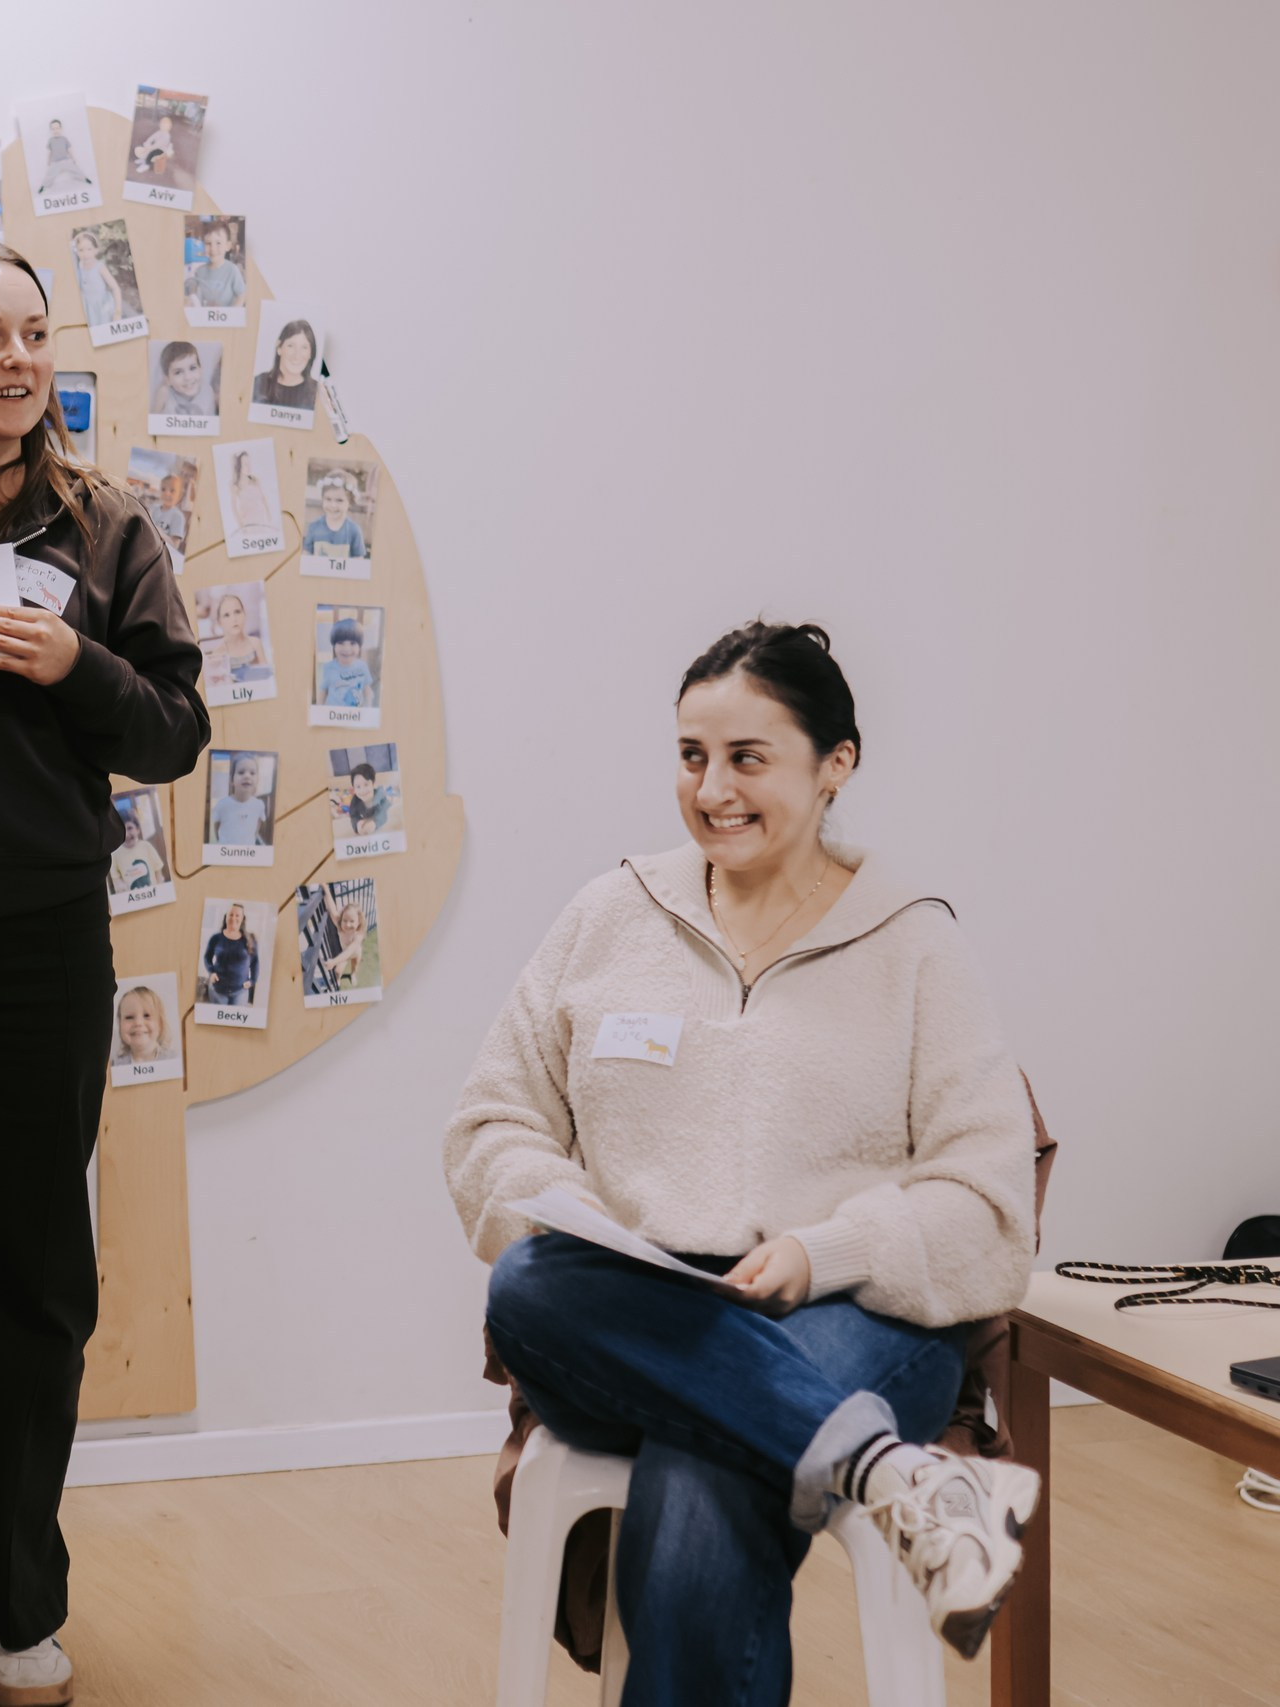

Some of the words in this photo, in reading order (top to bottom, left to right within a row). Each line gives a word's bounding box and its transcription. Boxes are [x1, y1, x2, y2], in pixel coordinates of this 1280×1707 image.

[43, 194, 78, 210] David
[80, 192, 90, 204] S
[148, 188, 176, 203] Aviv
[207, 310, 228, 322] Rio
[109, 319, 144, 336] Maya
[270, 408, 302, 423] Danya
[165, 416, 209, 430] Shahar
[241, 536, 279, 551] Segev
[328, 559, 347, 571] Tal
[232, 687, 254, 702] Lily
[328, 710, 362, 722] Daniel
[220, 846, 257, 858] Sunnie
[345, 841, 379, 857] David
[381, 840, 391, 852] C
[127, 887, 157, 904] Assaf
[329, 994, 349, 1006] Niv
[216, 1010, 249, 1024] Becky
[133, 1064, 155, 1076] Noa
